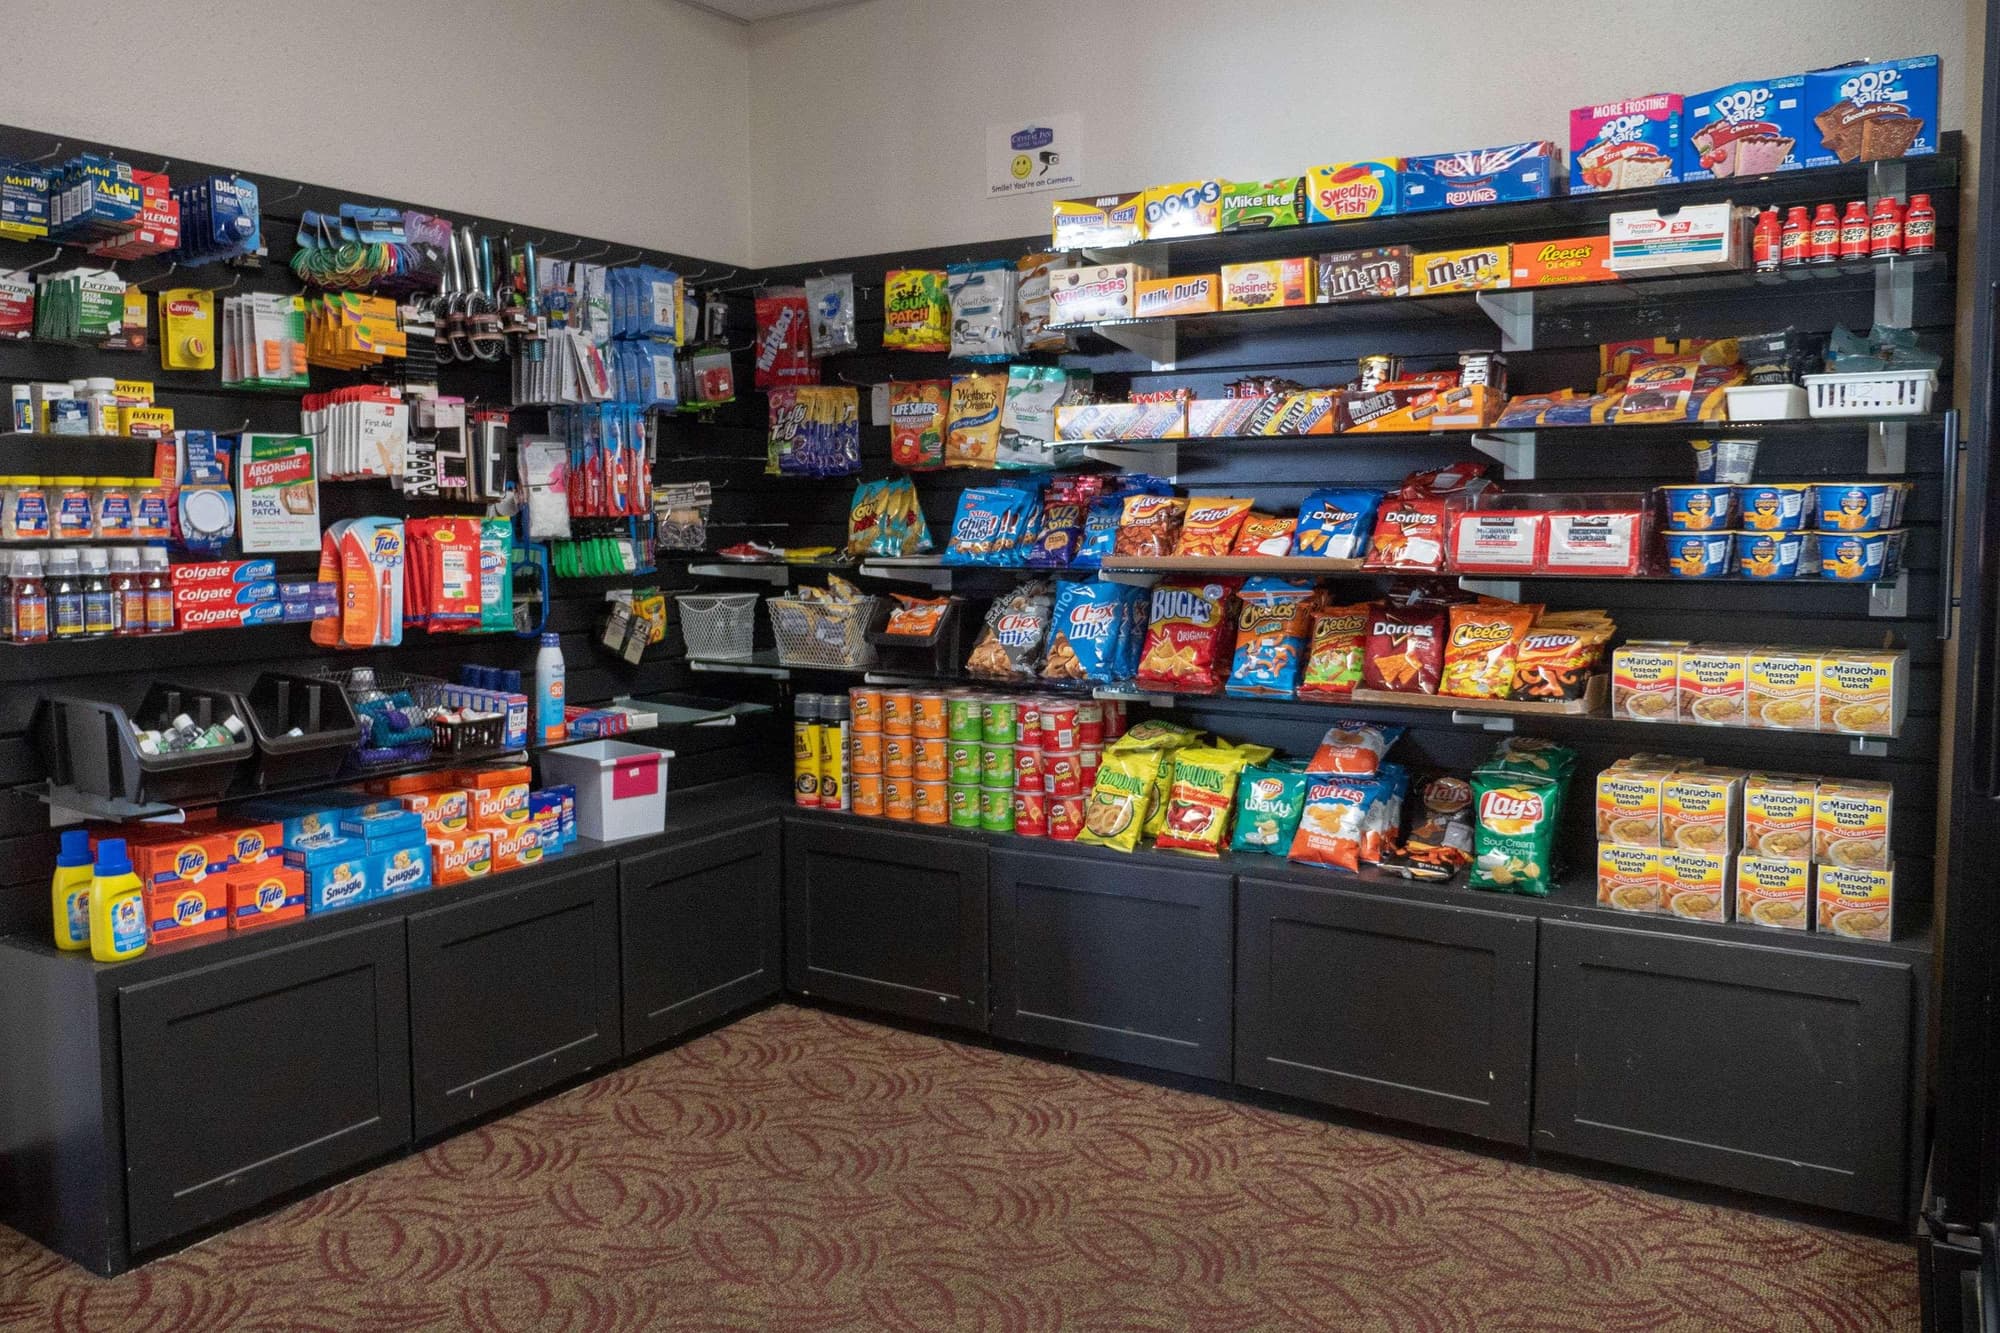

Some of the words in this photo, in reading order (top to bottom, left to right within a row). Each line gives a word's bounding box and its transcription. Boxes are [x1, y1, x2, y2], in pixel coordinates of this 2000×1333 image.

[1593, 103, 1623, 119] MORE
[1625, 96, 1669, 113] FROSTING!
[1730, 123, 1760, 134] Cherry
[1914, 138, 1925, 148] 12
[1784, 154, 1795, 164] 12
[97, 179, 139, 201] Advil
[1320, 185, 1378, 206] Swedish
[1096, 196, 1119, 207] MINI
[1146, 182, 1220, 221] DOTS
[1224, 195, 1262, 209] Mike
[1266, 195, 1290, 207] Ike
[1335, 197, 1367, 216] Fish
[1056, 213, 1104, 227] CHARLESTON
[1111, 207, 1137, 223] CHEW
[1054, 279, 1126, 304] WHOPPERS
[1229, 281, 1278, 295] Raisinets
[1140, 290, 1168, 309] Milk
[1174, 280, 1208, 300] Duds
[890, 295, 928, 311] SOUR
[889, 305, 929, 323] PATCH
[955, 388, 997, 400] Werther's
[1132, 390, 1173, 404] TWIX
[964, 399, 994, 410] Original
[131, 411, 165, 421] BAYER
[1300, 396, 1332, 434] SNICKERS
[1353, 410, 1381, 425] VARIETY
[1379, 404, 1397, 417] PACK
[364, 418, 380, 428] First
[380, 420, 392, 428] Aid
[248, 458, 302, 477] ABSORBINE
[255, 475, 274, 486] PLUS
[251, 500, 275, 508] BACK
[251, 508, 281, 516] PATCH
[1191, 505, 1239, 522] Fritos
[1312, 510, 1359, 523] Doritos
[1385, 510, 1438, 526] Doritos
[957, 518, 990, 534] Chips
[374, 535, 400, 553] Tide
[175, 565, 231, 580] Colgate
[178, 587, 233, 602] Colgate
[1151, 590, 1214, 624] BUGLES
[185, 608, 240, 623] Colgate
[999, 615, 1041, 631] Chex
[1316, 616, 1366, 638] Cheetos
[1177, 629, 1211, 642] ORIGINAL
[1373, 622, 1433, 637] Doritos
[1453, 623, 1514, 647] Cheetos
[1525, 634, 1577, 650] Fritos
[1627, 656, 1673, 667] Maruchan
[1693, 660, 1741, 670] Maruchan
[1762, 661, 1812, 672] Maruchan
[1630, 666, 1662, 674] Instant
[1765, 671, 1800, 679] Instant
[1834, 665, 1887, 677] Maruchan
[1838, 676, 1873, 684] Instant
[1841, 682, 1869, 690] Lunch
[1636, 683, 1655, 691] Beef
[1702, 686, 1721, 694] Beef
[1771, 687, 1800, 697] Chicken
[1843, 692, 1873, 702] Chicken
[1175, 761, 1224, 793] Funyuns
[1610, 782, 1656, 794] Maruchan
[1675, 786, 1722, 799] Maruchan
[1309, 785, 1364, 804] RUFFLES
[1613, 792, 1644, 800] Instant
[1760, 794, 1810, 805] Maruchan
[480, 793, 522, 818] bounce
[1678, 797, 1711, 805] Instant
[1681, 803, 1708, 811] Lunch
[1831, 801, 1882, 813] Maruchan
[1613, 806, 1642, 816] Chicken
[1764, 804, 1798, 812] Instant
[1767, 810, 1794, 818] Lunch
[1678, 813, 1709, 822] Chicken
[1834, 811, 1869, 819] Instant
[1763, 819, 1796, 828] Chicken
[1837, 817, 1865, 826] Lunch
[1833, 826, 1867, 837] Chicken
[236, 838, 262, 857] Tide
[498, 831, 536, 857] bounce
[1482, 836, 1503, 846] Sour
[1505, 838, 1536, 849] Cream
[444, 844, 483, 870] bounce
[1612, 850, 1658, 862] Maruchan
[177, 853, 205, 874] Tide
[1615, 860, 1646, 868] Instant
[1672, 856, 1719, 869] Maruchan
[1753, 862, 1802, 875] Maruchan
[386, 865, 421, 887] Snuggle
[1674, 866, 1706, 874] Instant
[1677, 872, 1703, 880] Lunch
[1614, 874, 1644, 884] Chicken
[1756, 873, 1790, 881] Instant
[1759, 879, 1786, 887] Lunch
[1834, 872, 1886, 884] Maruchan
[326, 879, 363, 901] Snuggle
[1674, 880, 1705, 891] Chicken
[1837, 882, 1872, 892] Instant
[258, 886, 283, 906] Tide
[1755, 888, 1788, 898] Chicken
[1840, 889, 1869, 897] Lunch
[176, 899, 204, 920] Tide
[1836, 898, 1872, 909] Chicken
